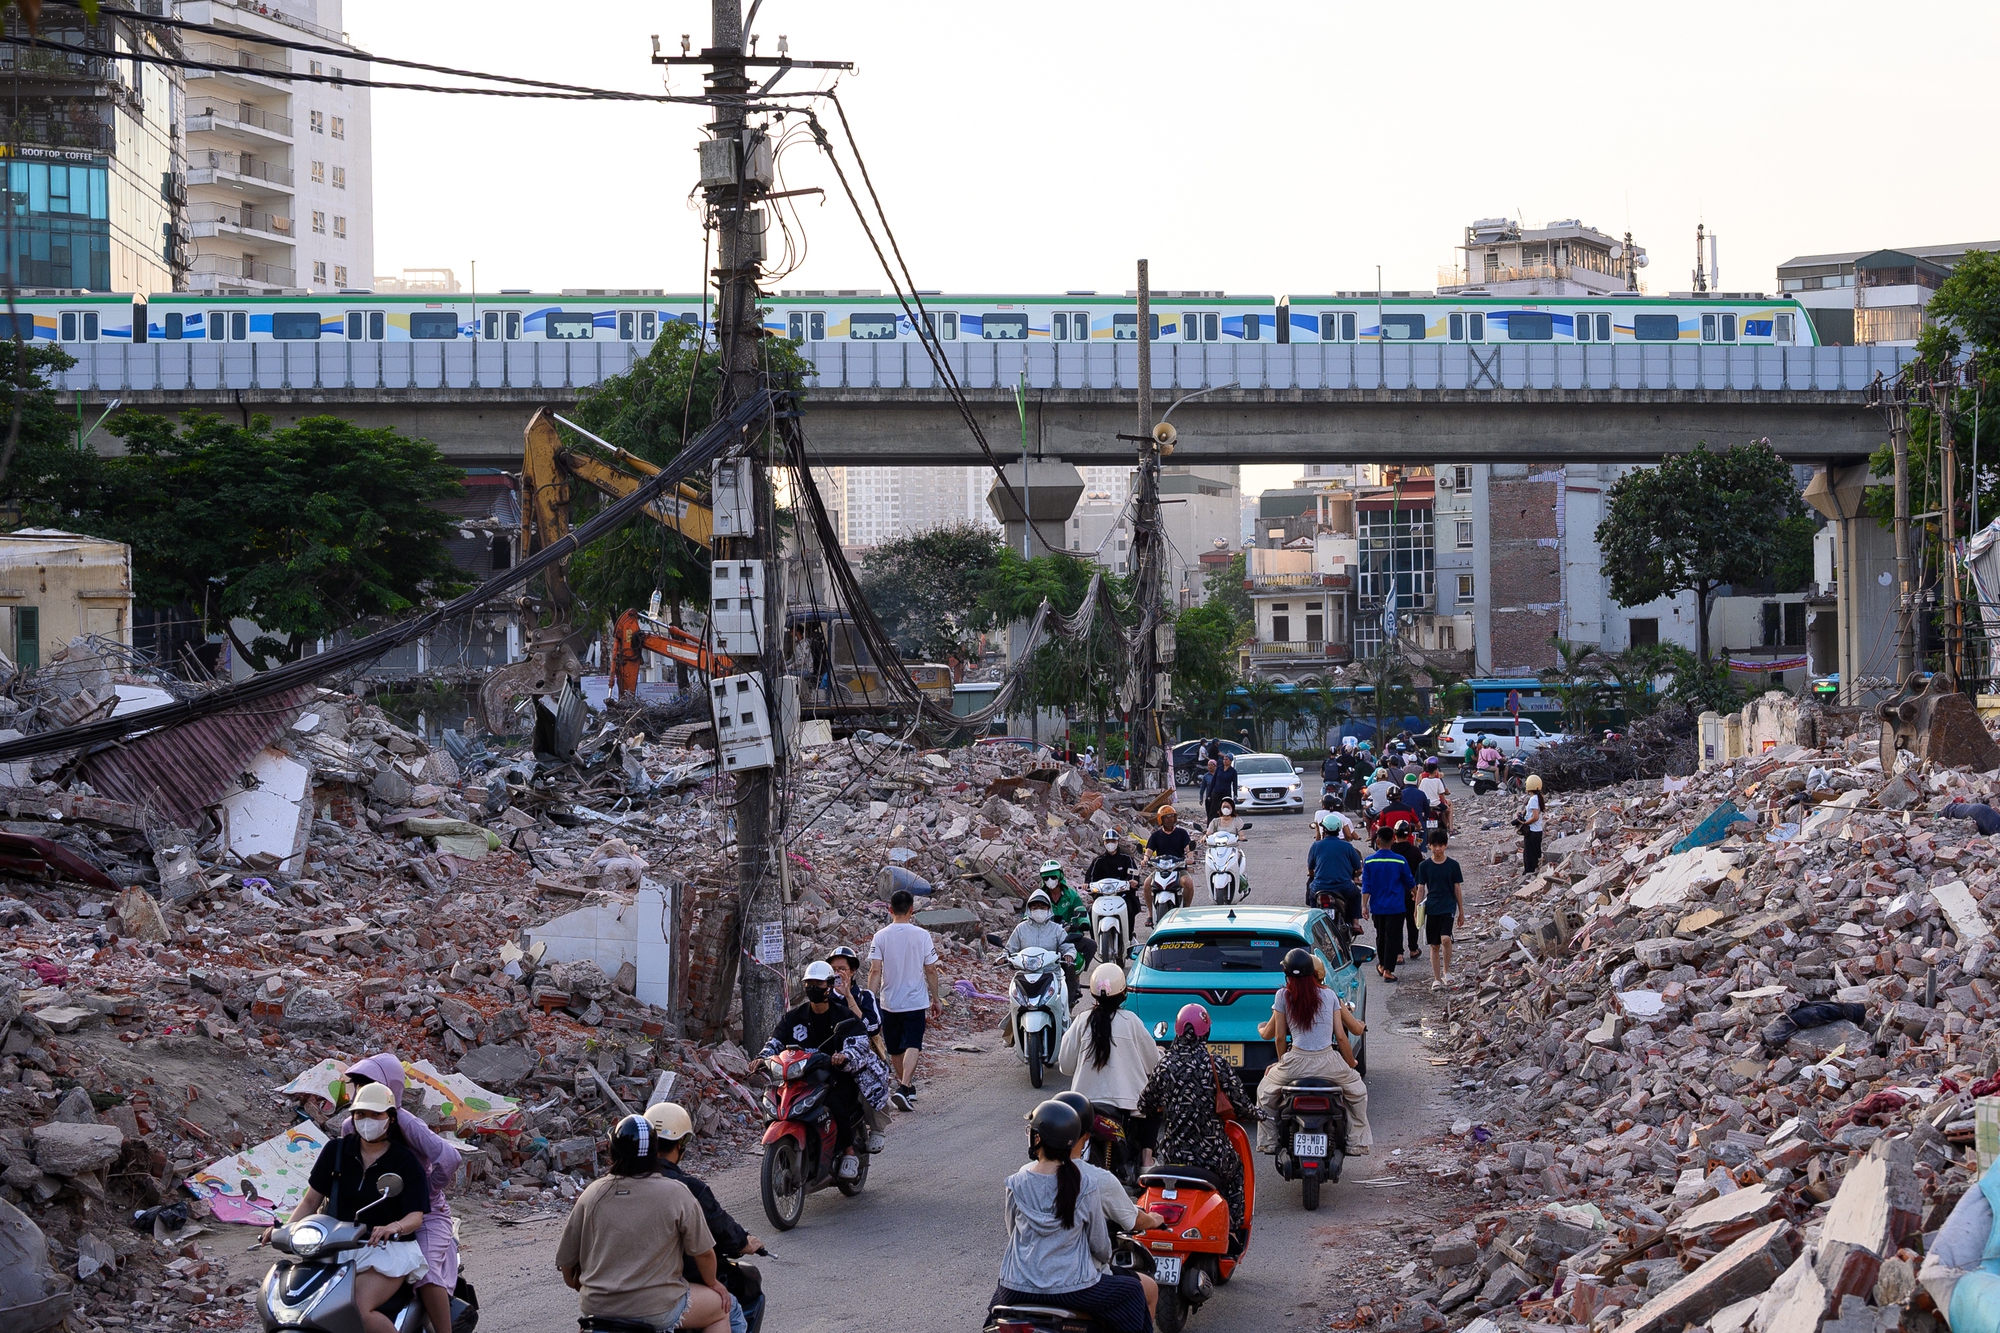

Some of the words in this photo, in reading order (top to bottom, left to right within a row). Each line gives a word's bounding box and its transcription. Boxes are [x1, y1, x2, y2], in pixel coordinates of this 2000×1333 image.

[21, 148, 60, 158] ROOFTOP
[65, 151, 93, 161] COFFEE
[595, 477, 620, 495] KOBELCO
[1210, 1044, 1231, 1055] 29H
[1296, 1145, 1325, 1156] 719.05
[1154, 1257, 1176, 1270] 9-S1
